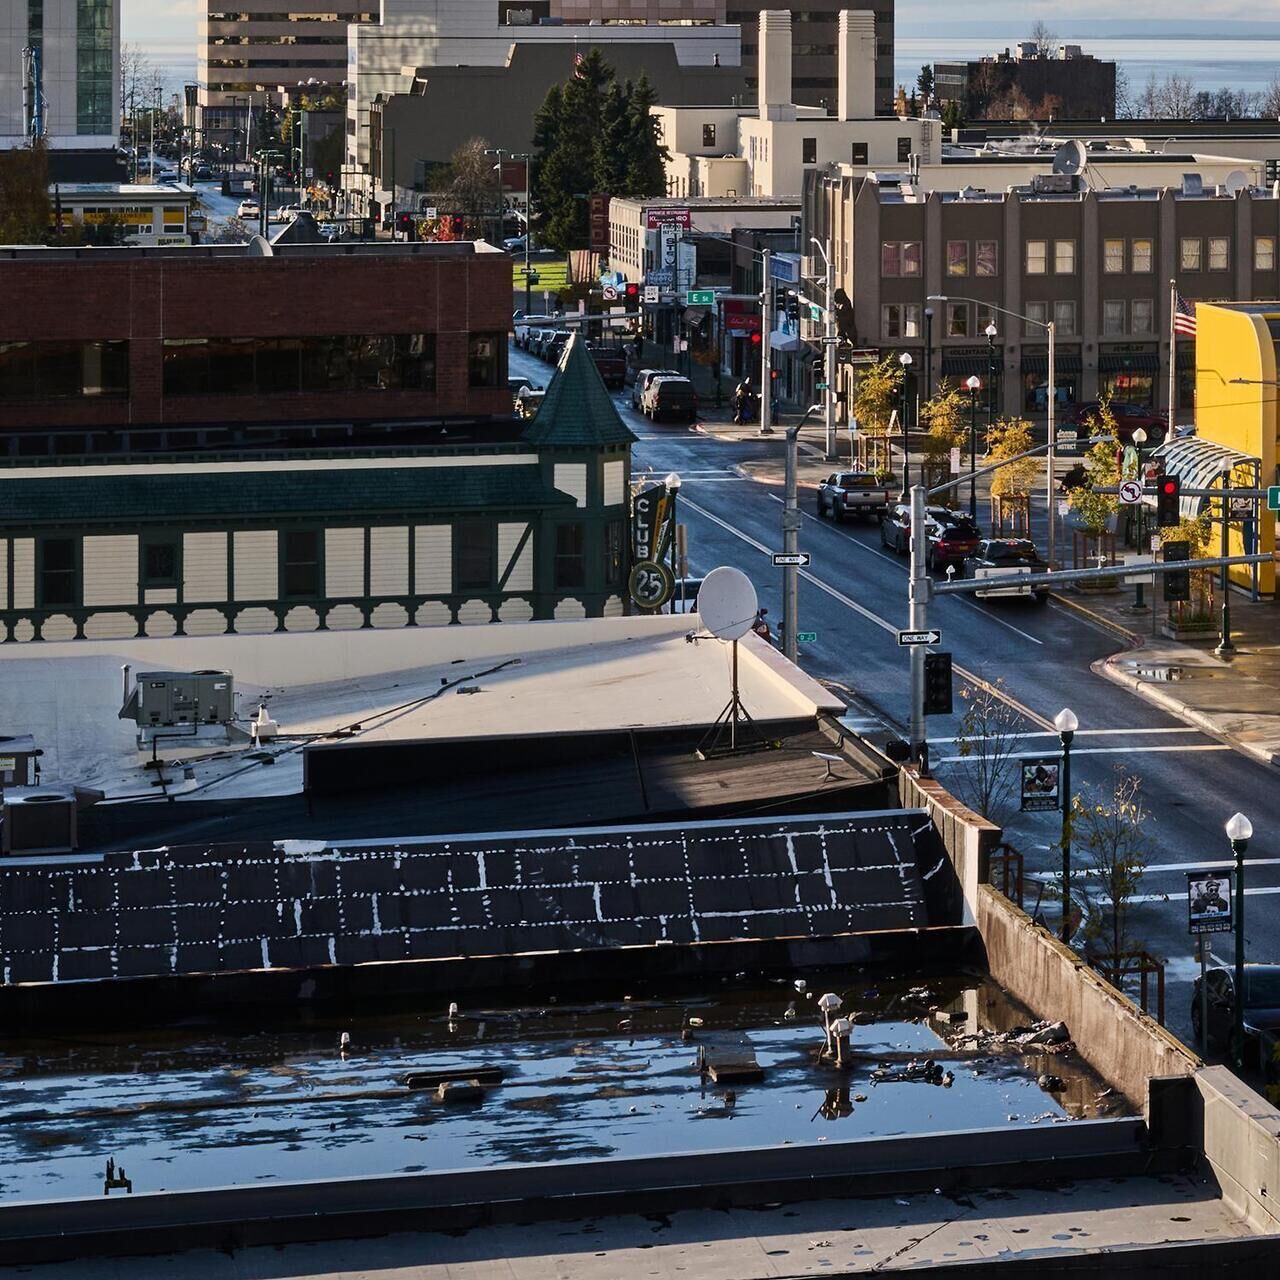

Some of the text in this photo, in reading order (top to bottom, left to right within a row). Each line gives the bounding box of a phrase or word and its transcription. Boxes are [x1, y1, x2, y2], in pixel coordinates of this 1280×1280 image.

[692, 293, 698, 302] E
[636, 498, 650, 559] CLUB
[637, 570, 662, 601] 25
[903, 633, 928, 641] ONE WAY
